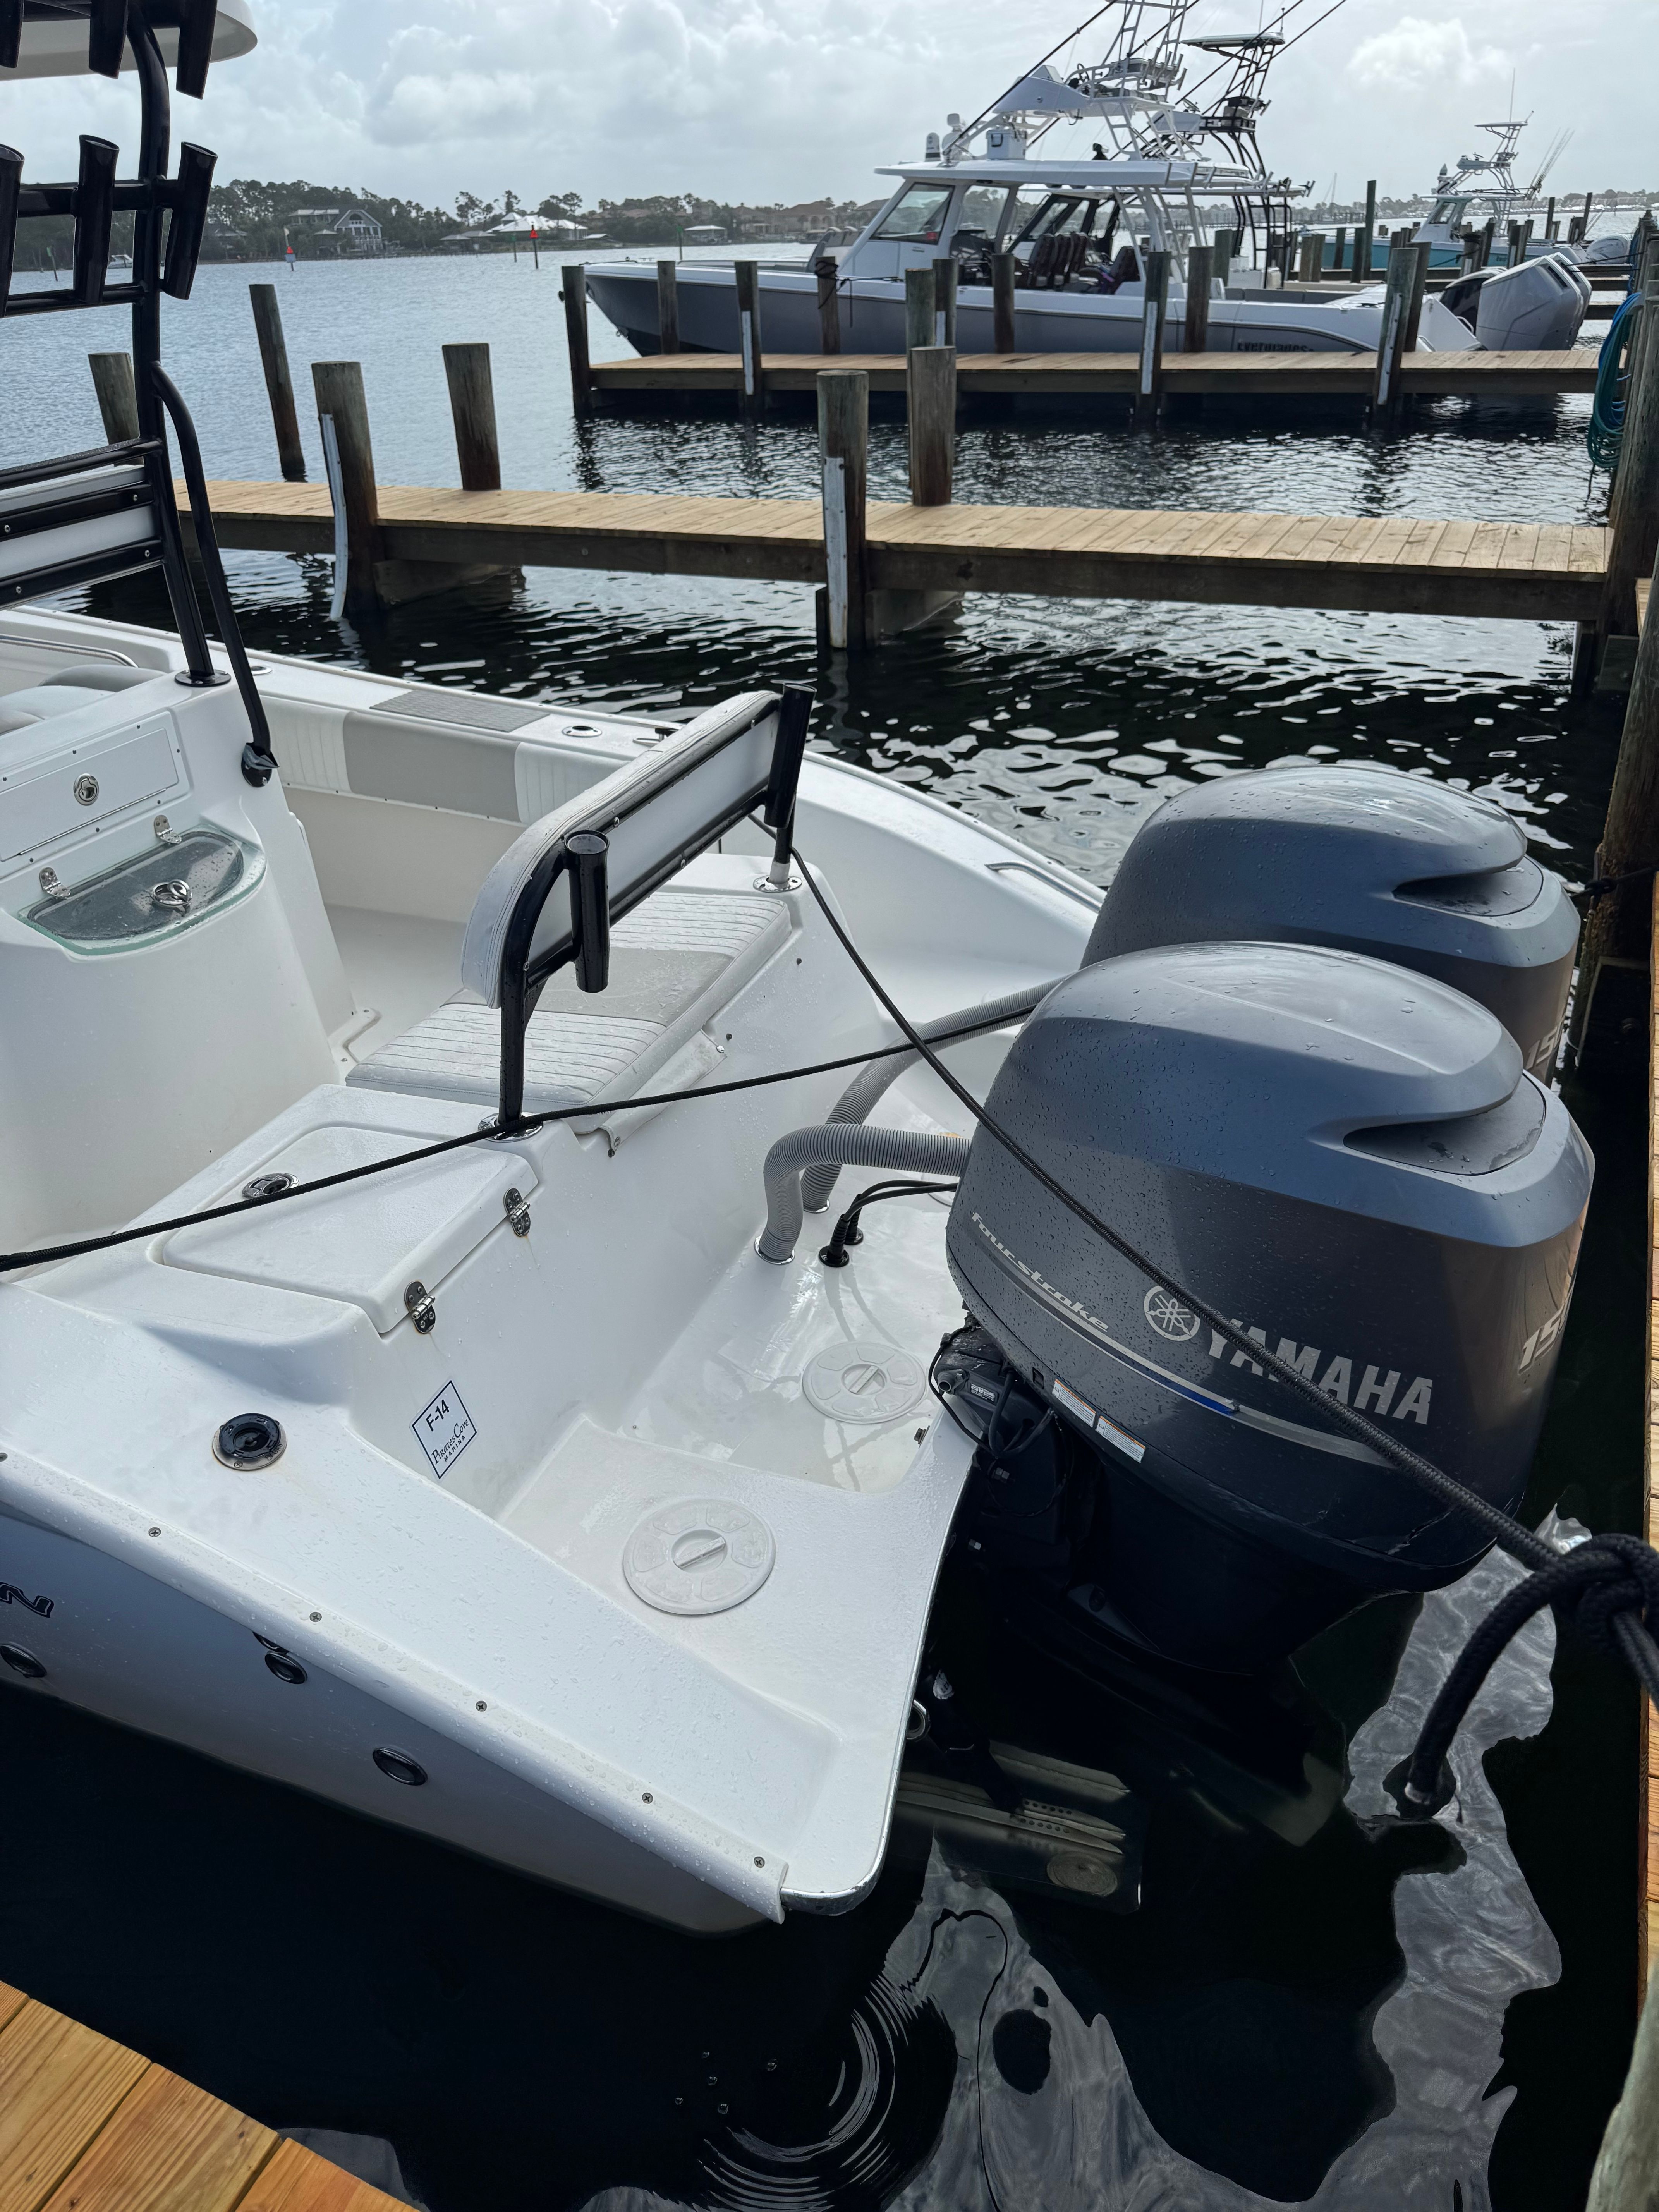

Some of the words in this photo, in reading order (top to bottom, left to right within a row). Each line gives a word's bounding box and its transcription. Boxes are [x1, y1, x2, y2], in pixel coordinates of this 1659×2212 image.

[1209, 1318, 1433, 1425] YAMAHA
[426, 1399, 450, 1432] F-14
[444, 1435, 465, 1462] MARINA
